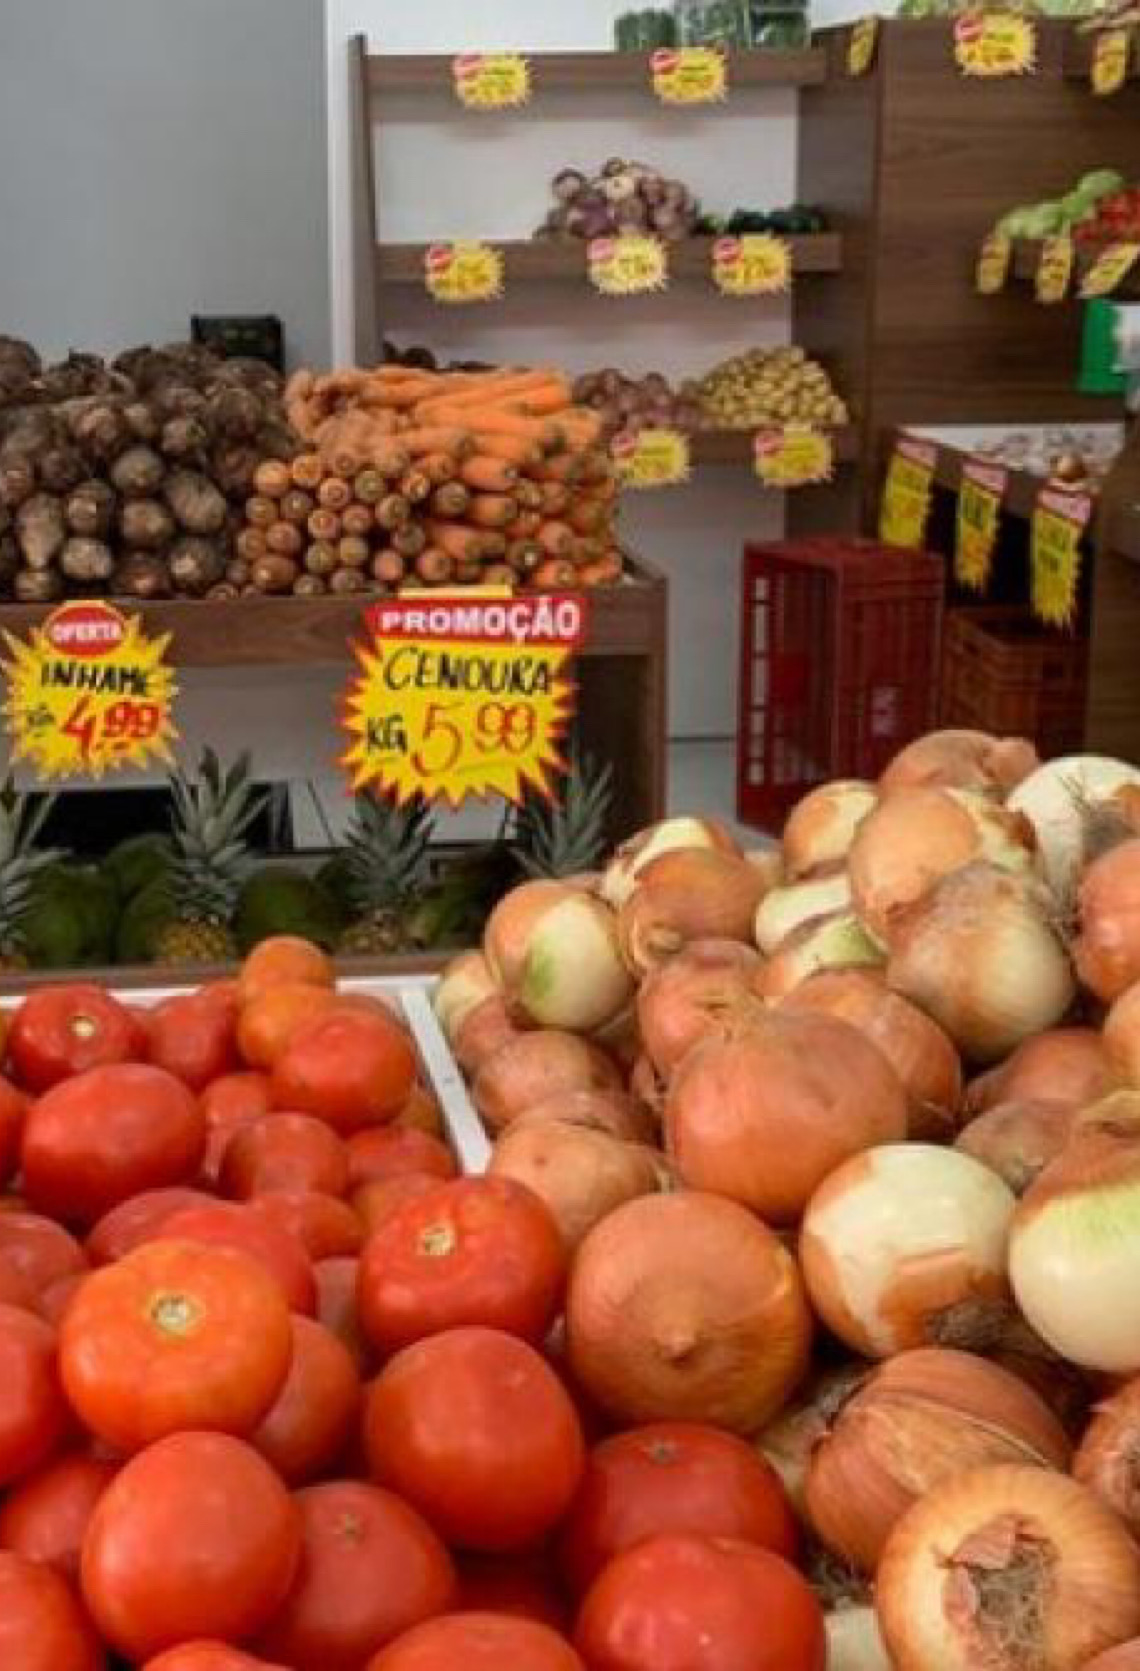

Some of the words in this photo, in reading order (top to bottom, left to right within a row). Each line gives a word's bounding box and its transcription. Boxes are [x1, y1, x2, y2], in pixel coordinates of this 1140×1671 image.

[53, 620, 122, 643] OFERTA
[380, 597, 581, 645] PROMOÇÃO
[383, 647, 551, 696] CENOURA
[366, 713, 408, 755] KG
